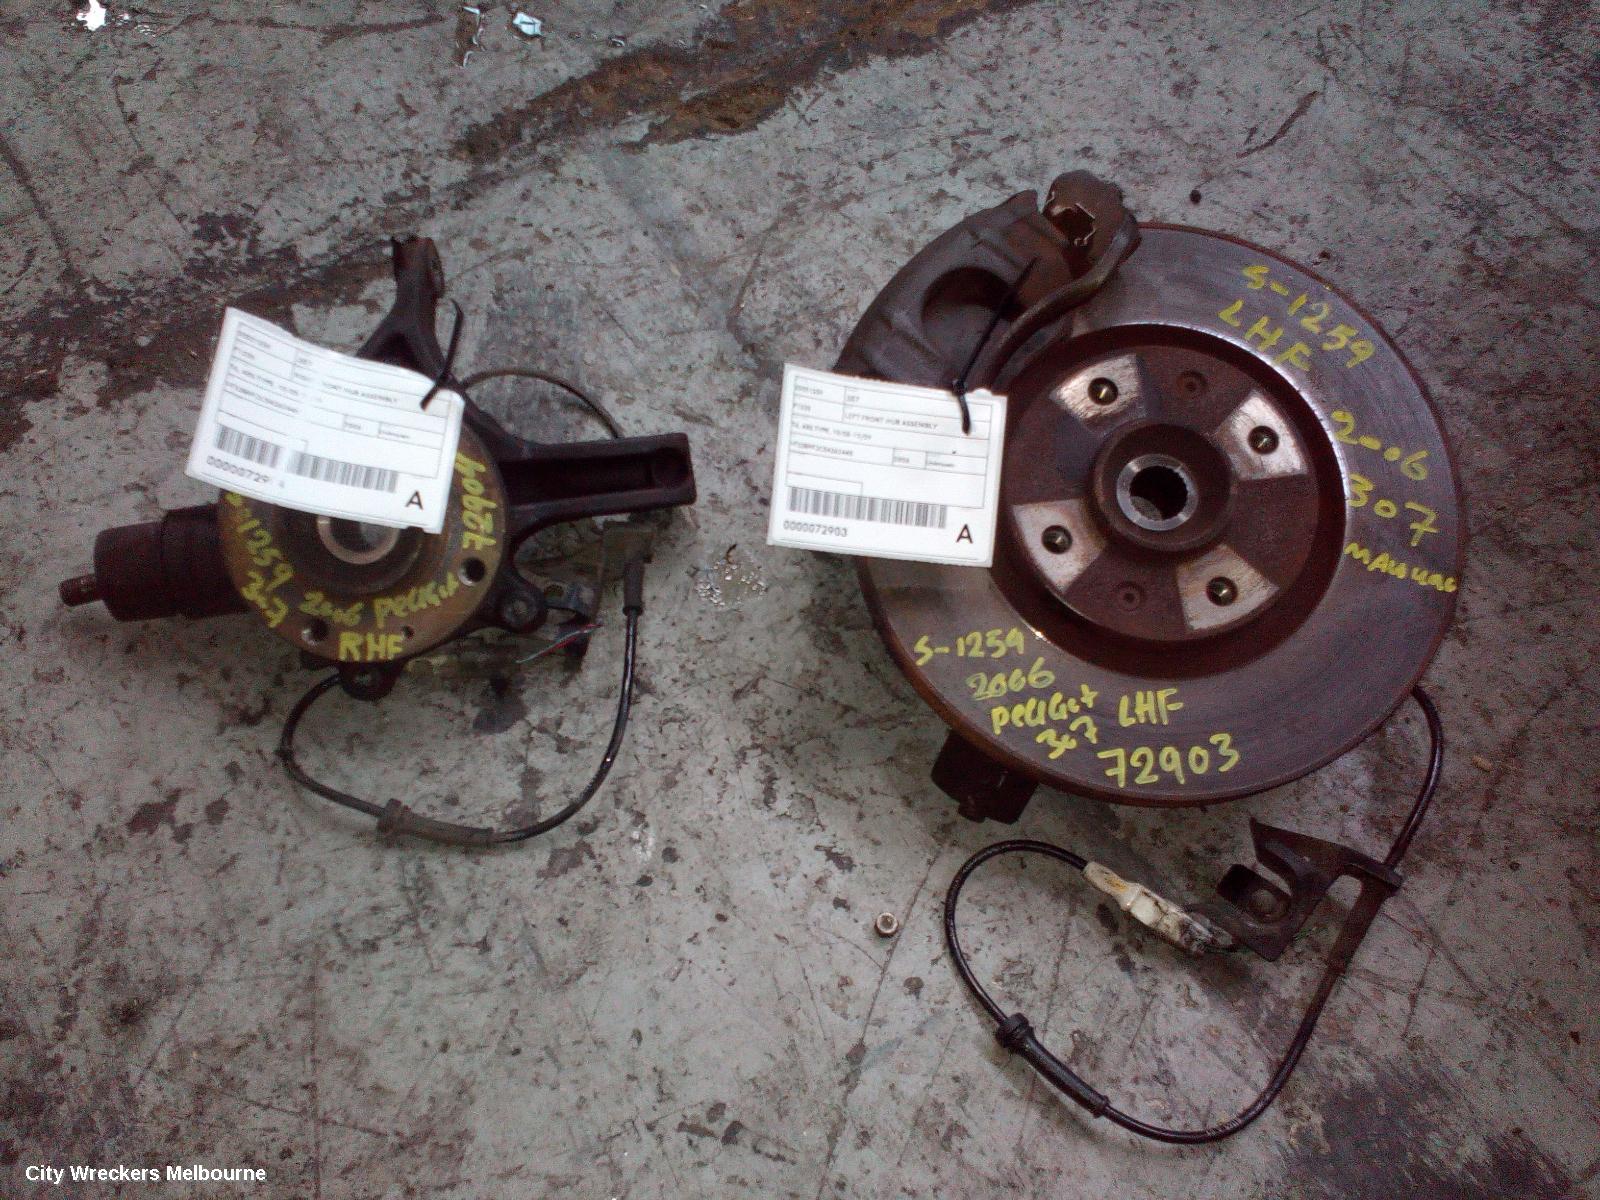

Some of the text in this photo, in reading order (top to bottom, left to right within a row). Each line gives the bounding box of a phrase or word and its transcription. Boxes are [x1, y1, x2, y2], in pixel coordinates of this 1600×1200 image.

[1217, 299, 1312, 372] LHF
[1242, 265, 1376, 368] S-1259
[901, 418, 939, 430] ASSEMBLY
[405, 490, 424, 510] A
[1348, 473, 1439, 548] 307
[783, 519, 848, 538] 0000072903
[956, 523, 974, 544] A
[337, 630, 406, 662] RHF
[912, 627, 1026, 667] S-1259
[965, 656, 1057, 701] 2006
[1117, 688, 1185, 728] LHF
[1097, 733, 1243, 789] 72903
